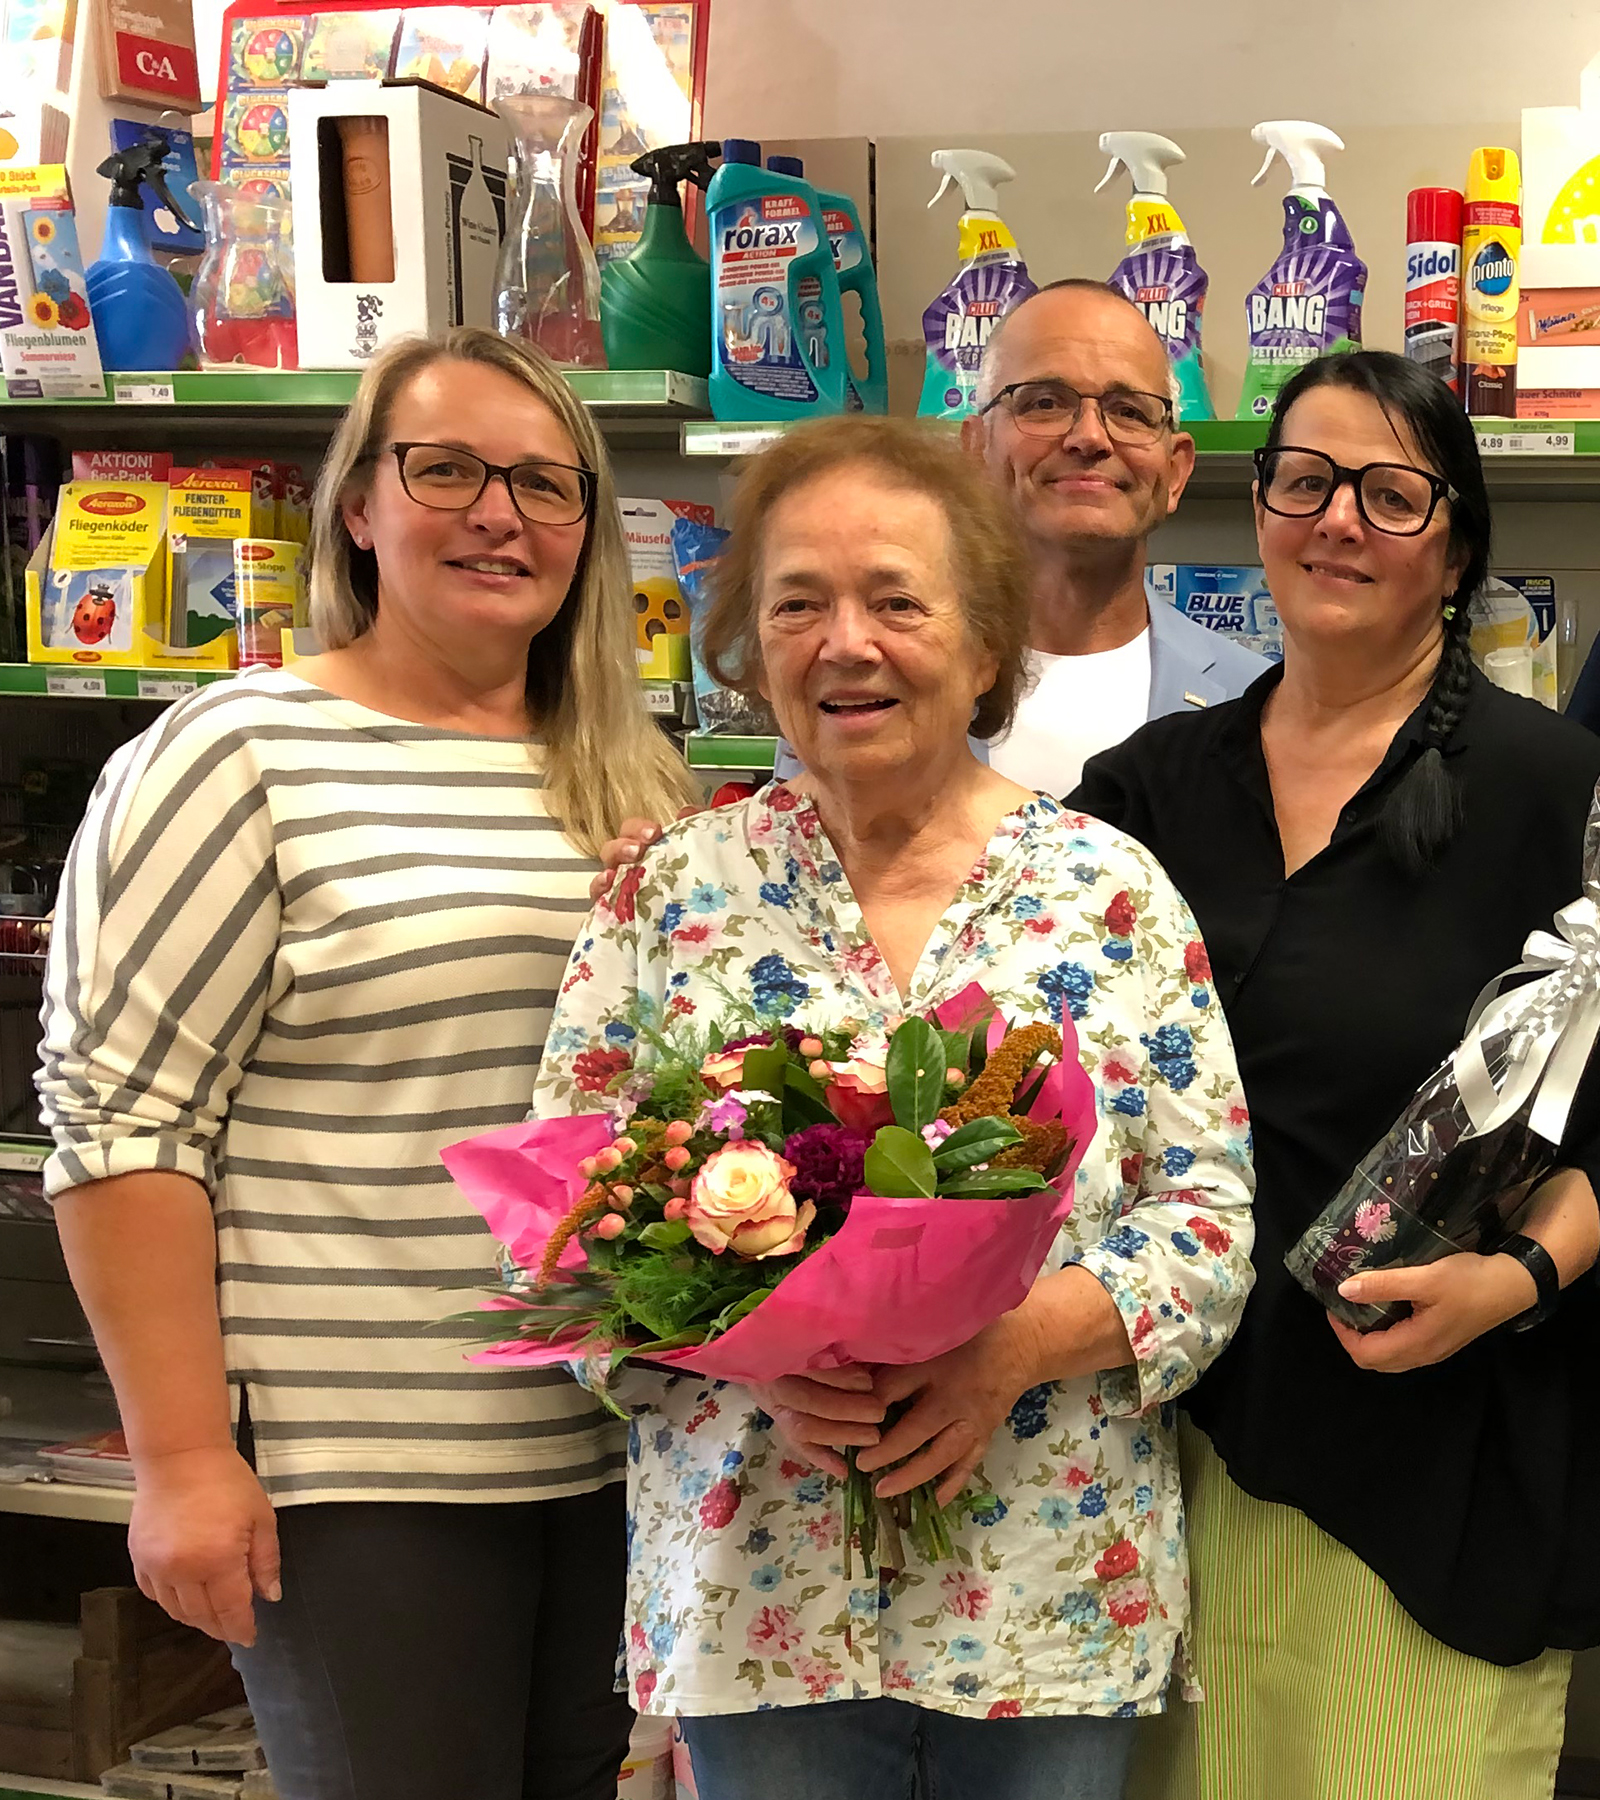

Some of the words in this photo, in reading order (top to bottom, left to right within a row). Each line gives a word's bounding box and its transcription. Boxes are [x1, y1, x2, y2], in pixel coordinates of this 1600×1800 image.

[136, 51, 177, 81] C&A
[765, 198, 795, 208] KRAFT-
[765, 207, 800, 217] FORMEL
[1147, 213, 1170, 235] XXL
[724, 222, 800, 251] rorax
[979, 230, 1002, 251] XXL
[742, 250, 776, 259] ACTION
[1407, 249, 1456, 282] Sidol
[1472, 257, 1514, 290] pronto
[1138, 288, 1167, 301] CILLIT
[1274, 282, 1304, 296] CILLIT
[761, 296, 774, 307] 4x
[969, 303, 997, 316] CILLIT
[1251, 294, 1324, 335] BANG
[1481, 304, 1504, 313] Pflege
[945, 314, 1000, 350] BAN
[5, 333, 87, 348] Fliegenblumen
[1478, 381, 1503, 389] Classic
[1542, 390, 1582, 399] Schnitte
[1481, 437, 1503, 449] 4,89
[1546, 435, 1569, 447] 4,99
[90, 469, 153, 482] 6er-Pack
[172, 472, 242, 489] Aeroxon
[66, 488, 72, 496] 4
[185, 493, 229, 504] FENSTER-
[173, 506, 241, 518] FLIEGENGITTER
[69, 519, 149, 533] Fliegenköder
[624, 532, 671, 544] Mäusefa
[1164, 573, 1174, 591] 1
[1187, 594, 1245, 613] BLUE
